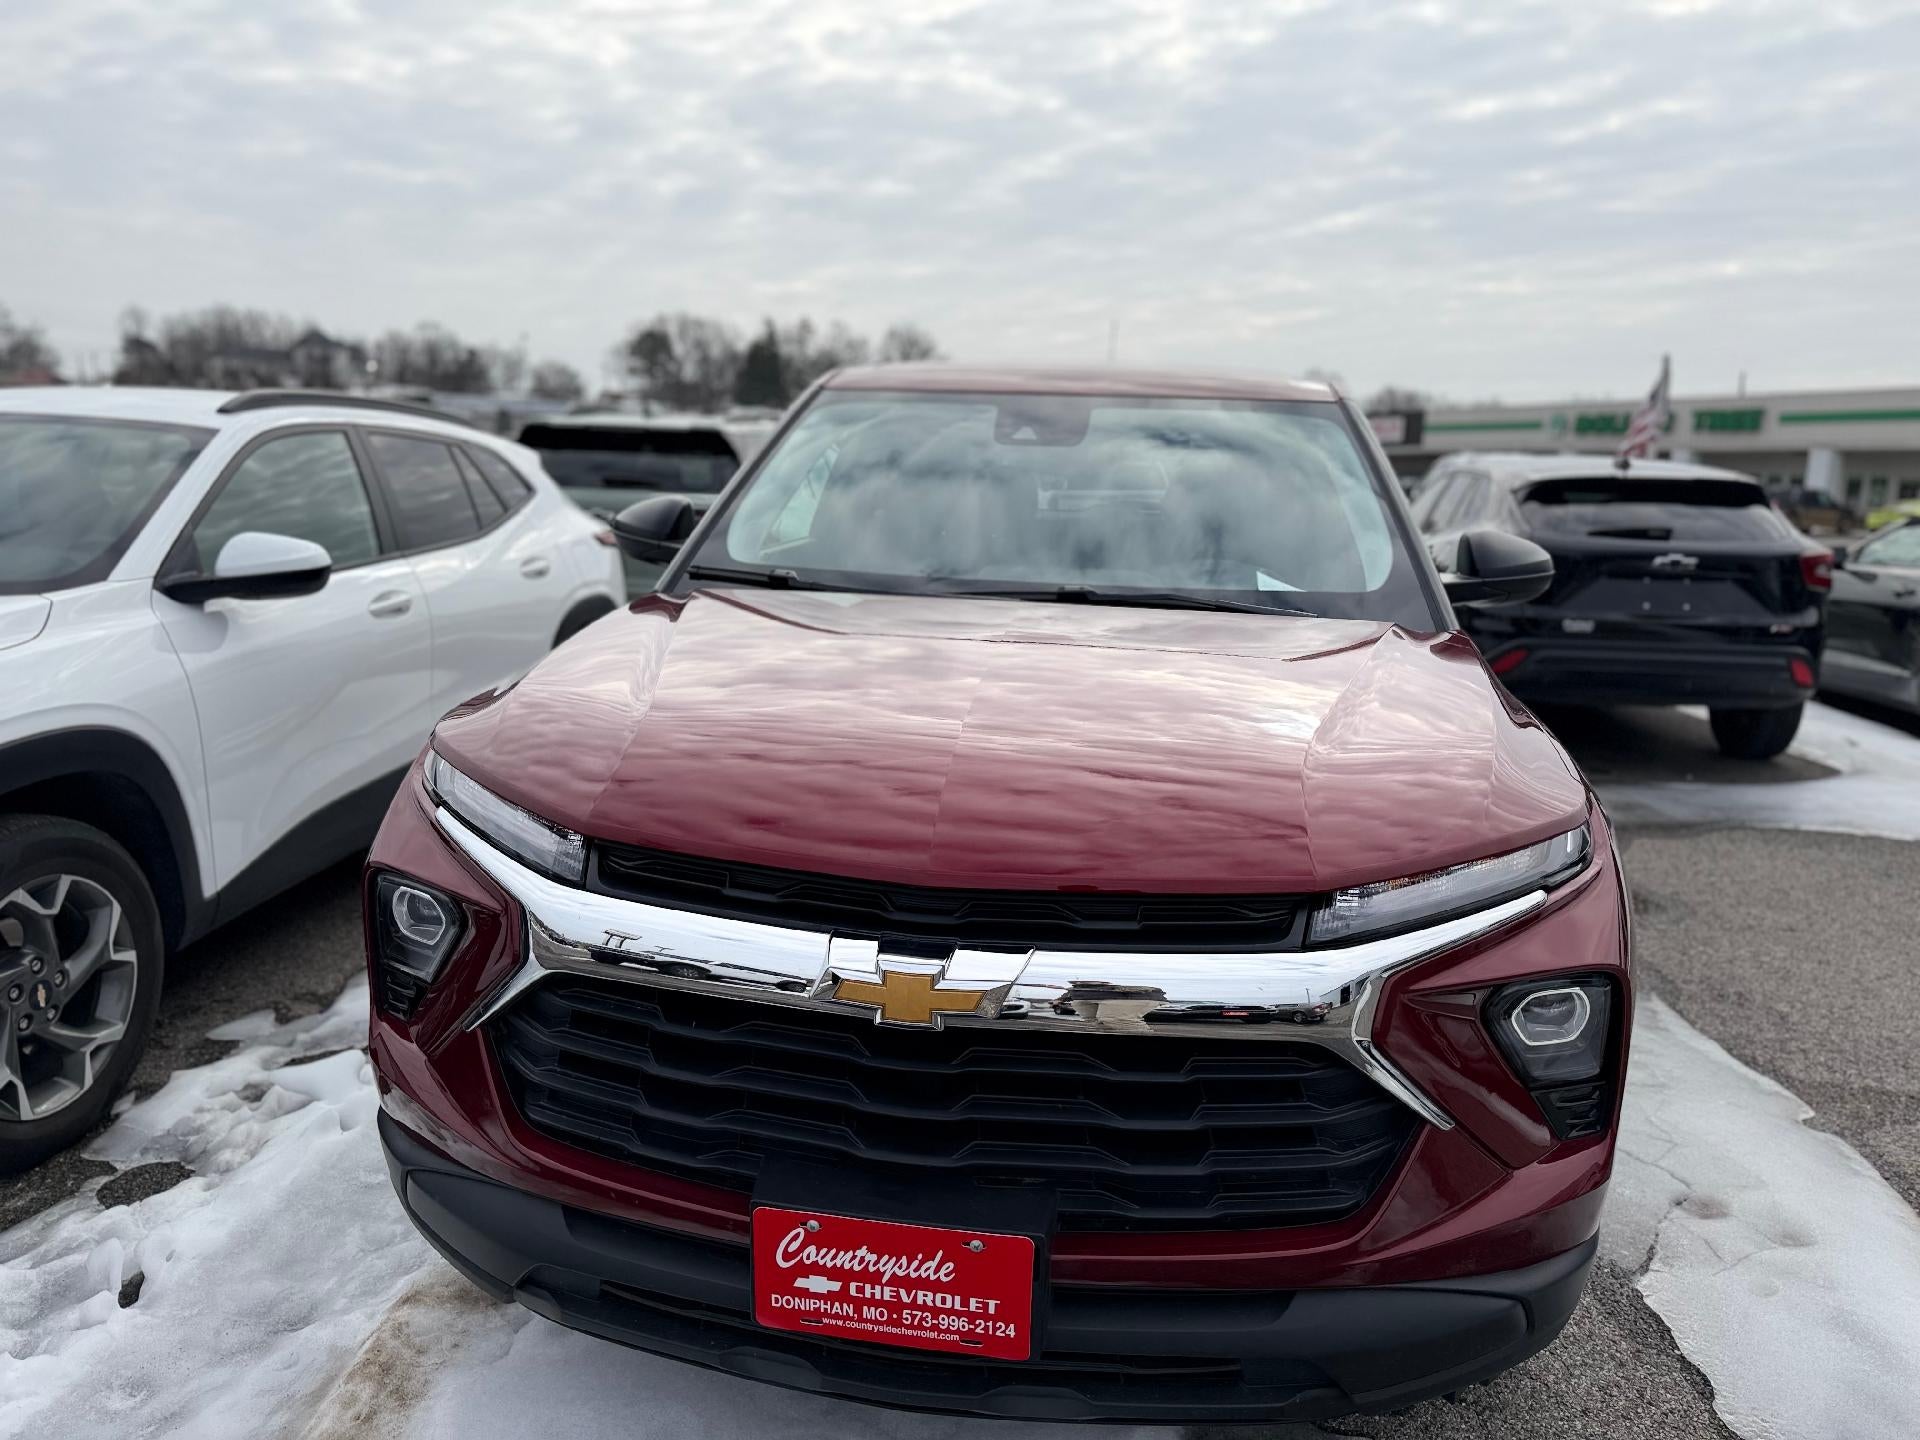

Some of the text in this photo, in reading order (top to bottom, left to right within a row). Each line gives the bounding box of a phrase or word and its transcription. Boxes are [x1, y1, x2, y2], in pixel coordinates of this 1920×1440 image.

[775, 1227, 955, 1283] Countryside
[771, 1294, 1016, 1338] DONIPHAN, MO 573-996-2124
[849, 1281, 1001, 1314] CHEVROLET
[822, 1316, 960, 1341] www.countrysidechevrolet.com
